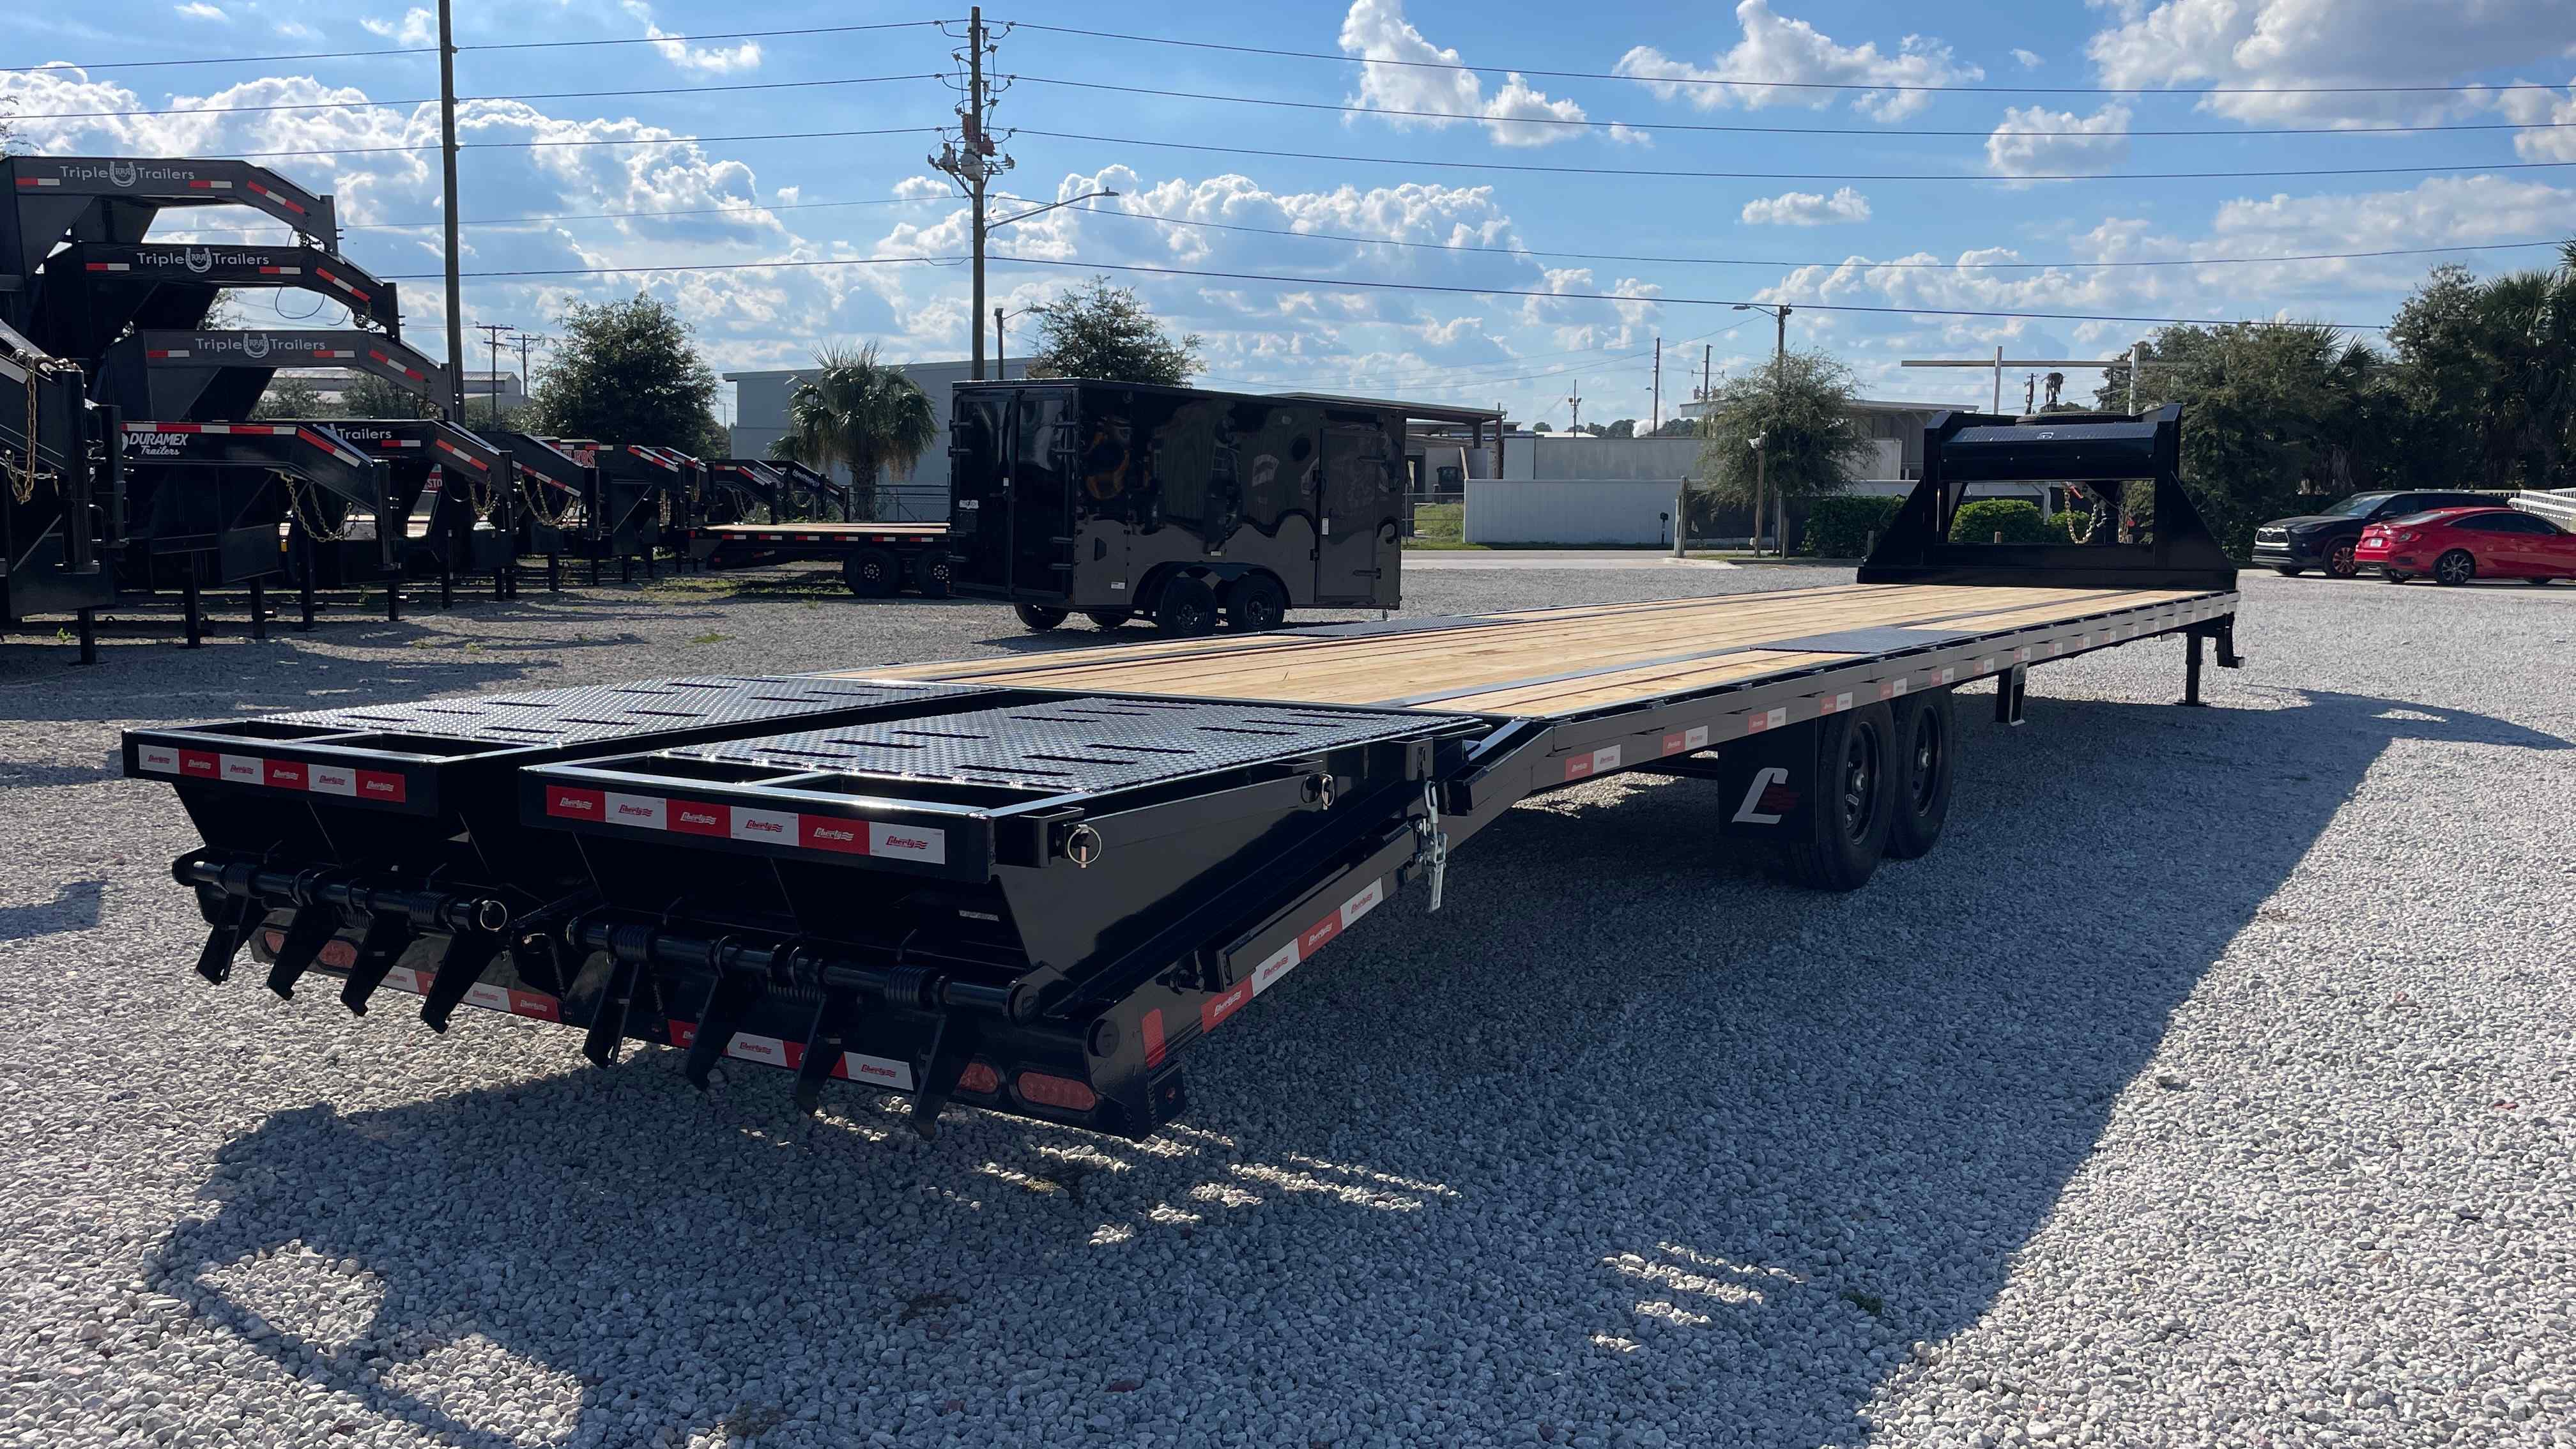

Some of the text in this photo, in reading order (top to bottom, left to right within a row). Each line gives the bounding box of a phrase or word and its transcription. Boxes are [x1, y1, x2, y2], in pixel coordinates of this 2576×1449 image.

[59, 165, 108, 180] Triple
[137, 167, 195, 180] Trailers
[137, 252, 185, 267] Triple
[212, 253, 270, 264] Trailers
[195, 338, 242, 352] Triple
[269, 338, 326, 349] Trailers
[129, 433, 188, 446] DURAMEX
[337, 428, 392, 439] Trailers
[141, 445, 180, 455] Trailers
[427, 479, 443, 487] STO
[560, 797, 583, 809] Liberty
[618, 804, 643, 816] Liberty
[680, 811, 706, 824] Liberty
[746, 819, 772, 831] Liberty
[814, 827, 843, 839] Liberty
[886, 835, 916, 848] Liberty
